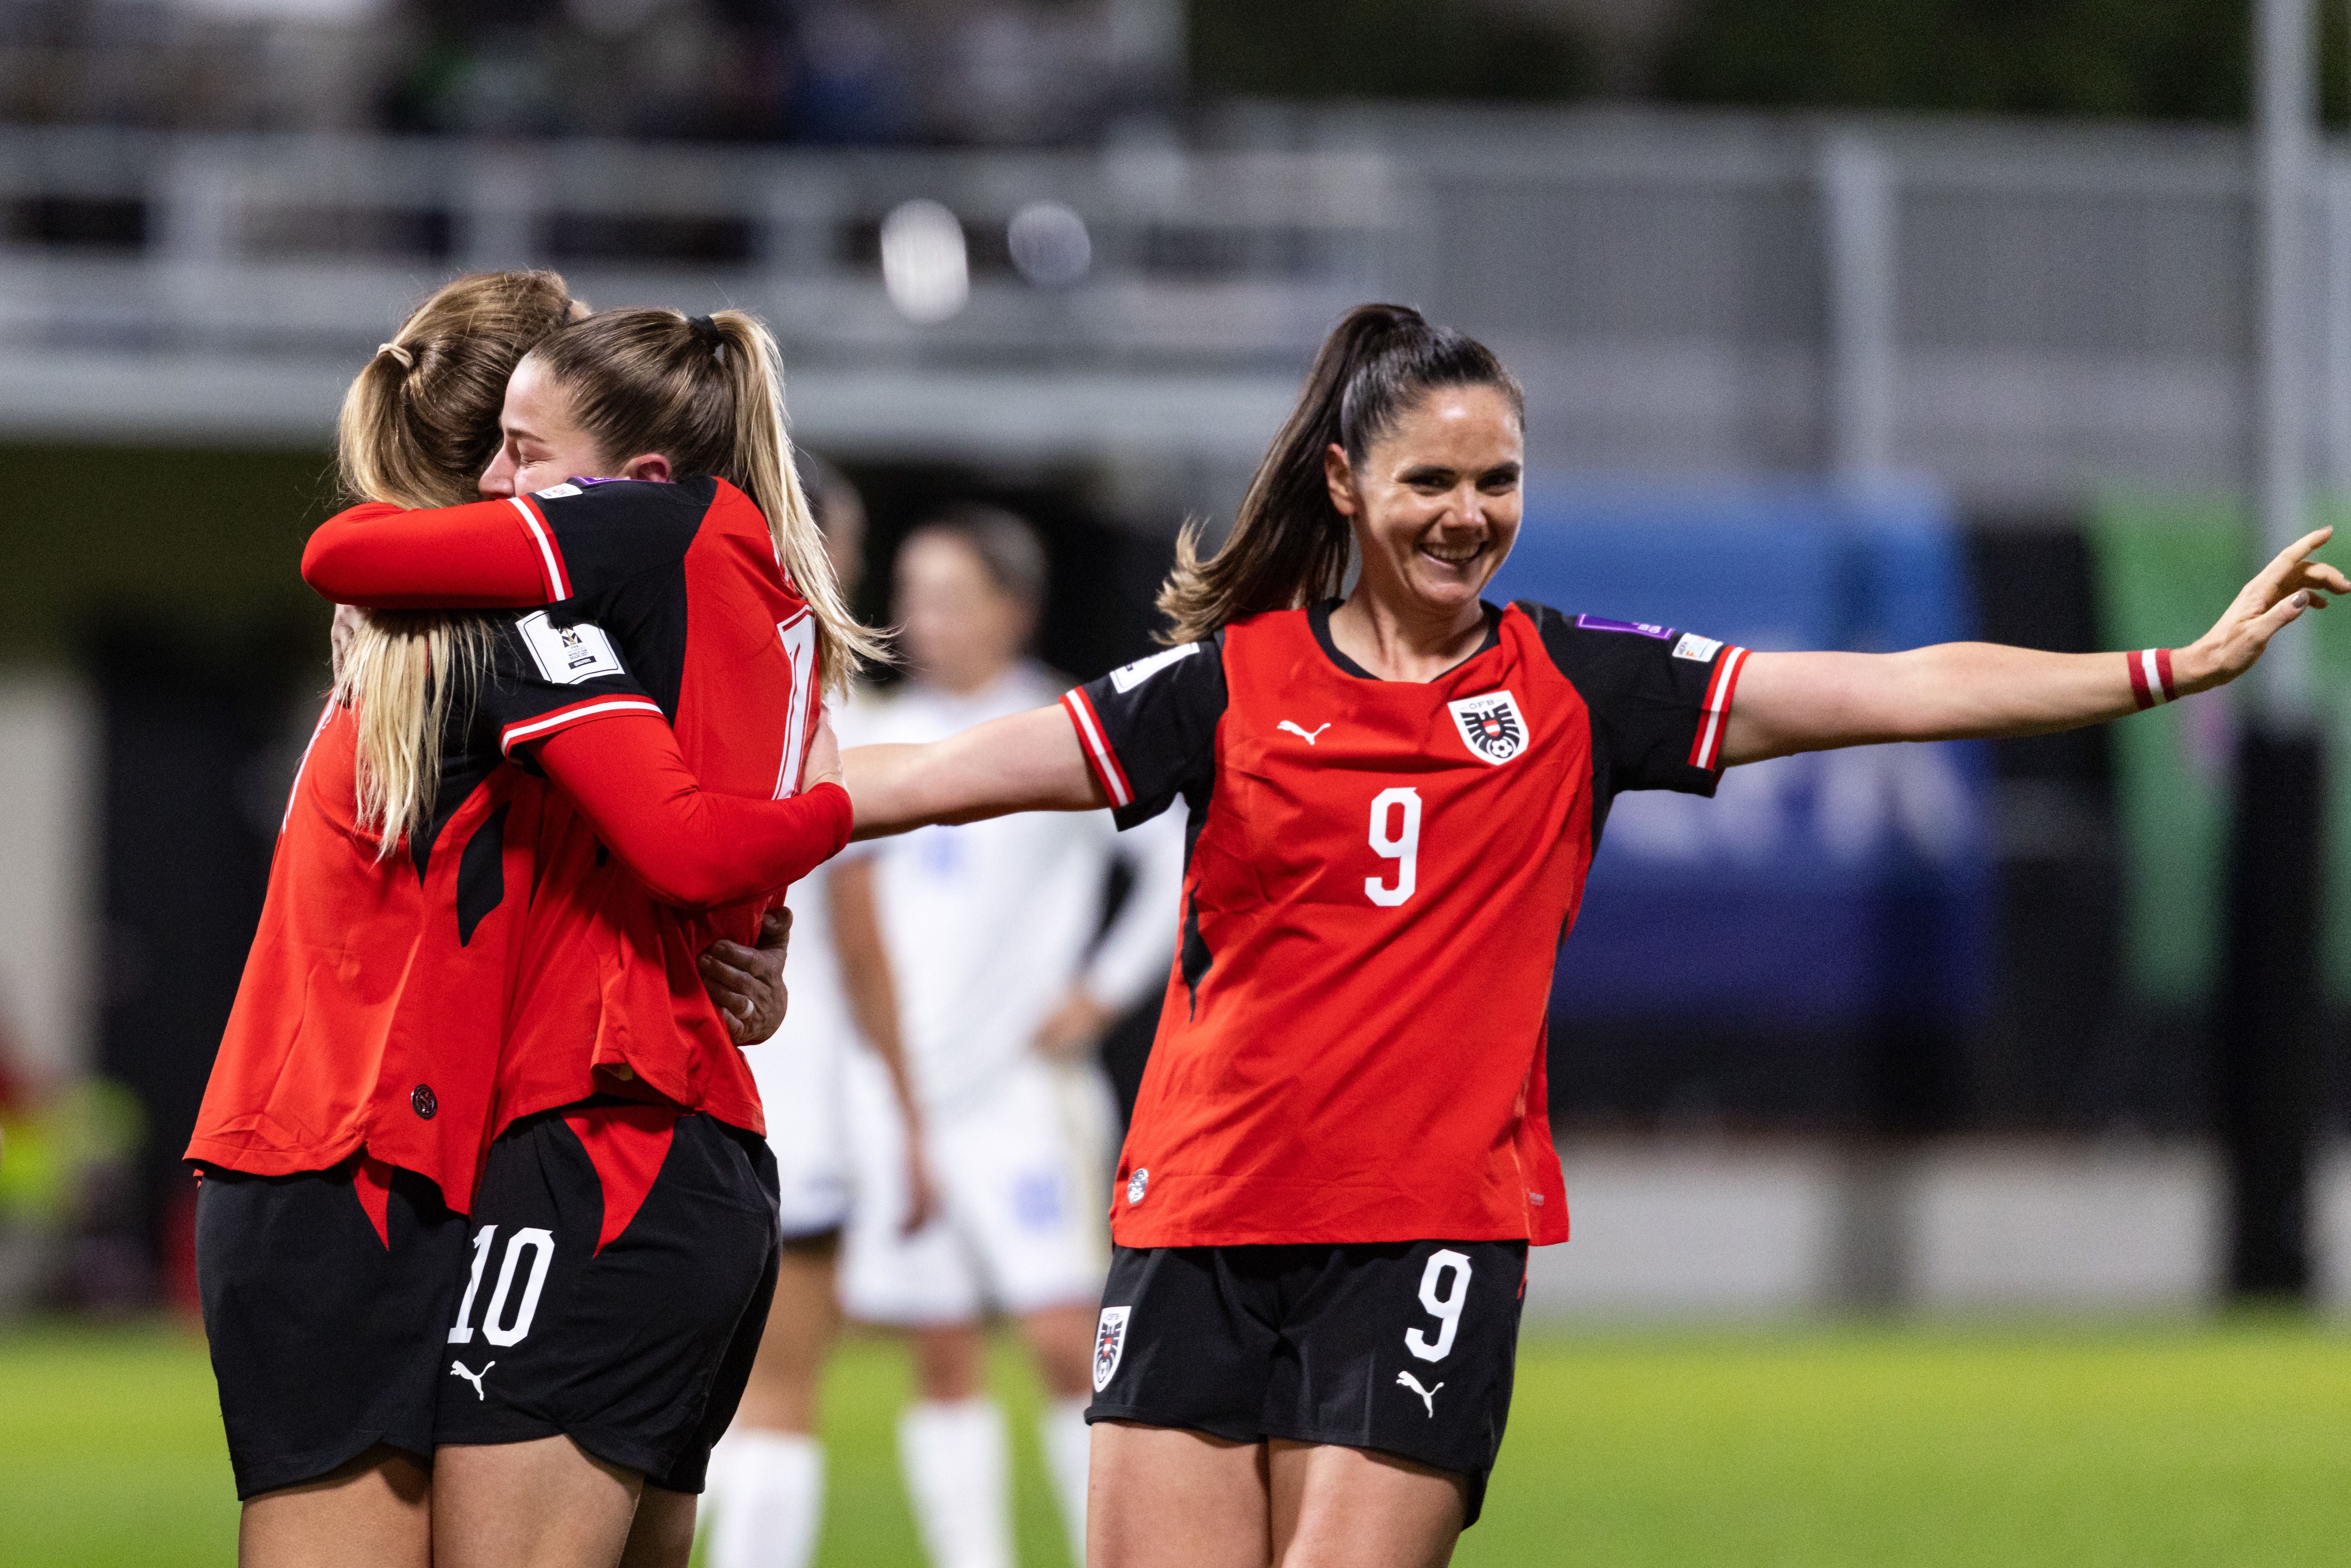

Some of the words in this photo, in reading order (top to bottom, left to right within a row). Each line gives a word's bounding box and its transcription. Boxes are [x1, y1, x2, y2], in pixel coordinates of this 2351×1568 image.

[1364, 787, 1422, 907] 9
[447, 1225, 555, 1347] 10
[1404, 1248, 1473, 1363] 9
